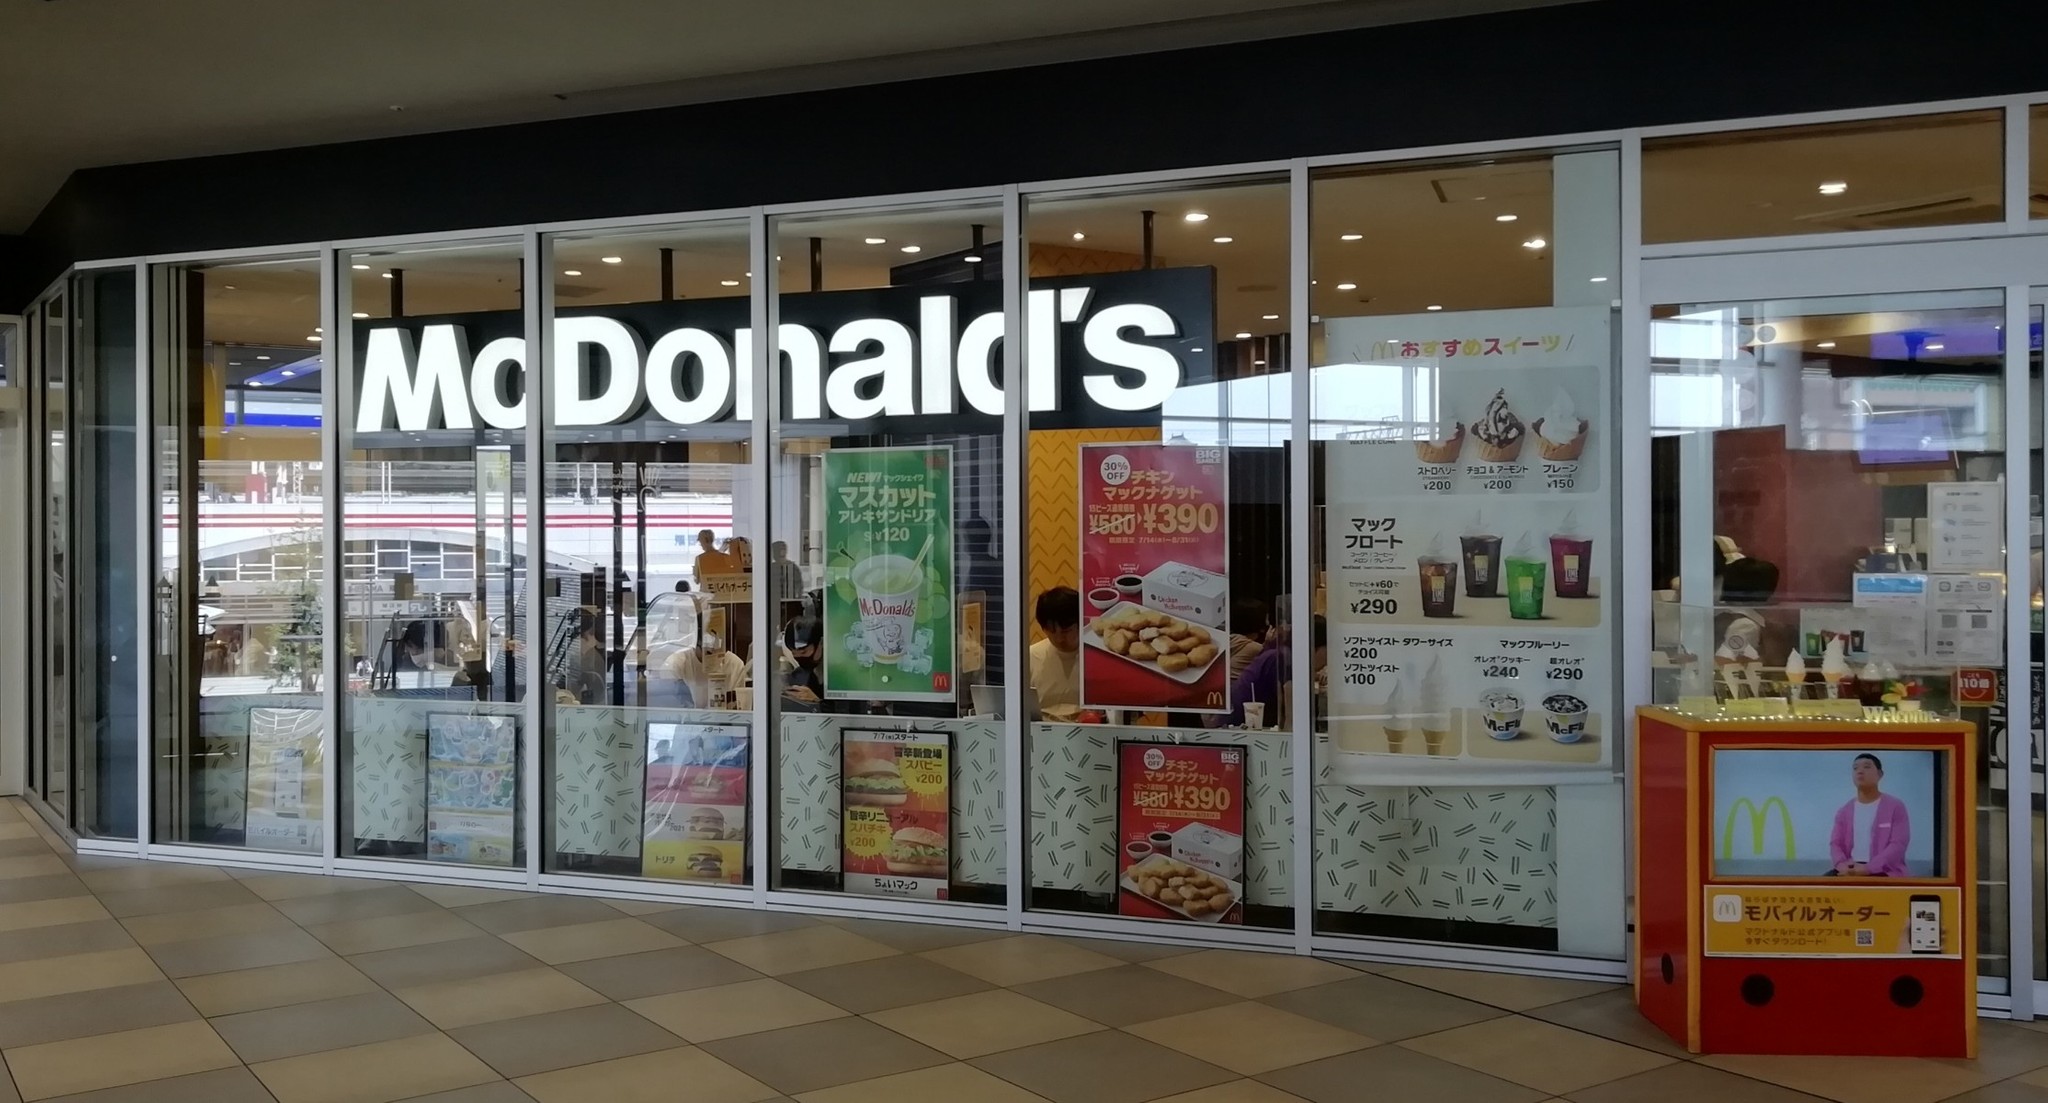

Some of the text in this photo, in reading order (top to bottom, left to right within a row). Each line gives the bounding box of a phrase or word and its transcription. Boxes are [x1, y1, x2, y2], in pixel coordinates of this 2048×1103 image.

[1401, 335, 1560, 358] おすすめスイーツ
[356, 287, 1183, 432] McDonald's
[1195, 449, 1221, 459] BIG
[1103, 462, 1128, 471] 30%
[1418, 466, 1456, 475] ストロベリー
[1543, 464, 1578, 474] プレーン
[847, 472, 882, 483] NEW!
[1106, 472, 1126, 480] OFF
[1130, 470, 1176, 485] チキン
[1424, 481, 1451, 490] ¥200
[1483, 480, 1512, 490] ¥200
[1547, 479, 1574, 489] ¥150
[838, 484, 937, 509] マスカット
[1102, 485, 1204, 501] マックナゲット
[838, 508, 937, 524] アレキサンドリア
[1143, 502, 1219, 534] ¥390
[1351, 518, 1396, 532] マック
[1345, 534, 1403, 549] フロート
[1350, 598, 1397, 615] ¥290
[1344, 636, 1454, 647] ソフトツイスト タワーサイズ
[1499, 640, 1570, 649] マックフルーリー
[1344, 647, 1378, 659] ¥200
[1344, 663, 1400, 673] ソフトツイスト
[1483, 665, 1519, 678] ¥240
[1546, 668, 1583, 680] ¥290
[1344, 673, 1376, 685] ¥100
[1165, 760, 1198, 771] チキン
[916, 774, 943, 784] ¥200
[1144, 770, 1219, 784] マックナゲット
[1174, 785, 1231, 810] ¥390
[850, 837, 876, 847] ¥200
[874, 878, 918, 890] ちょいマック
[1745, 905, 1891, 921] モバイルオーダー
